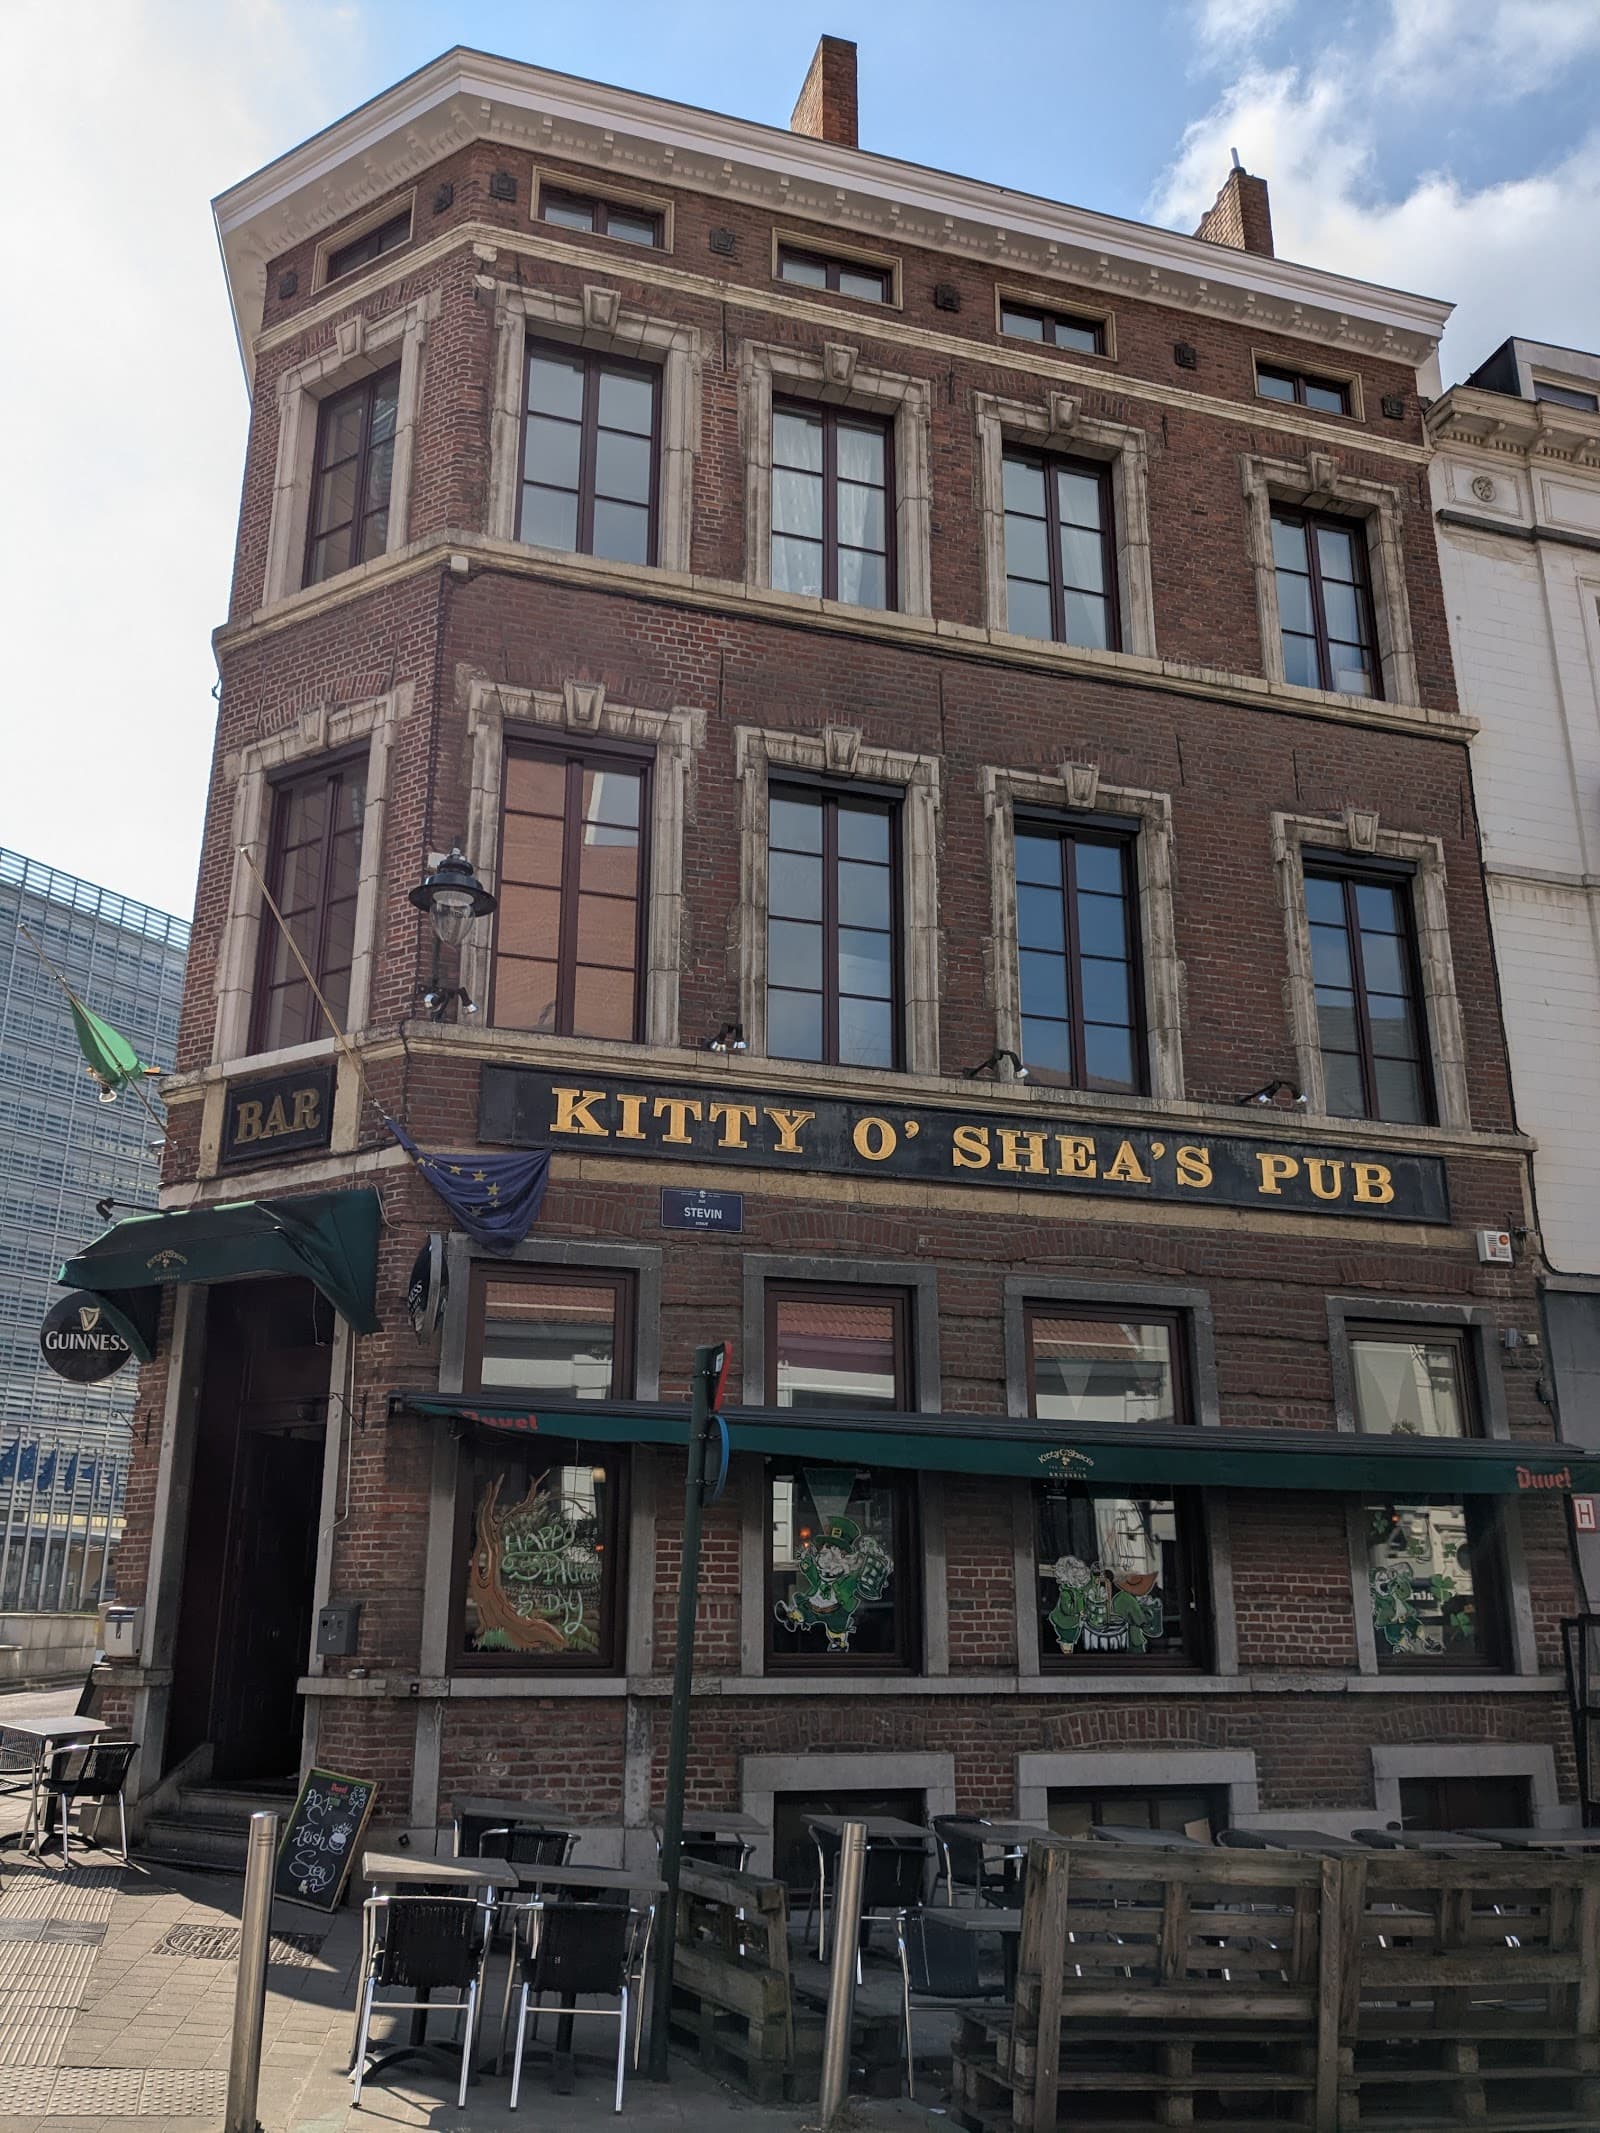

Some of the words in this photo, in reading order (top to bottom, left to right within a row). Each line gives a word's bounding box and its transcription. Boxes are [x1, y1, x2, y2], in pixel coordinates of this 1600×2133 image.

[234, 1088, 320, 1144] BAR
[549, 1086, 816, 1154] KITTY
[853, 1117, 920, 1161] O'
[952, 1125, 1213, 1189] SHEA'S
[1256, 1152, 1395, 1205] PUB
[684, 1206, 722, 1219] STEVIN
[45, 1330, 129, 1351] GUINNESS
[1515, 1466, 1572, 1489] Duvel
[1578, 1503, 1592, 1525] H
